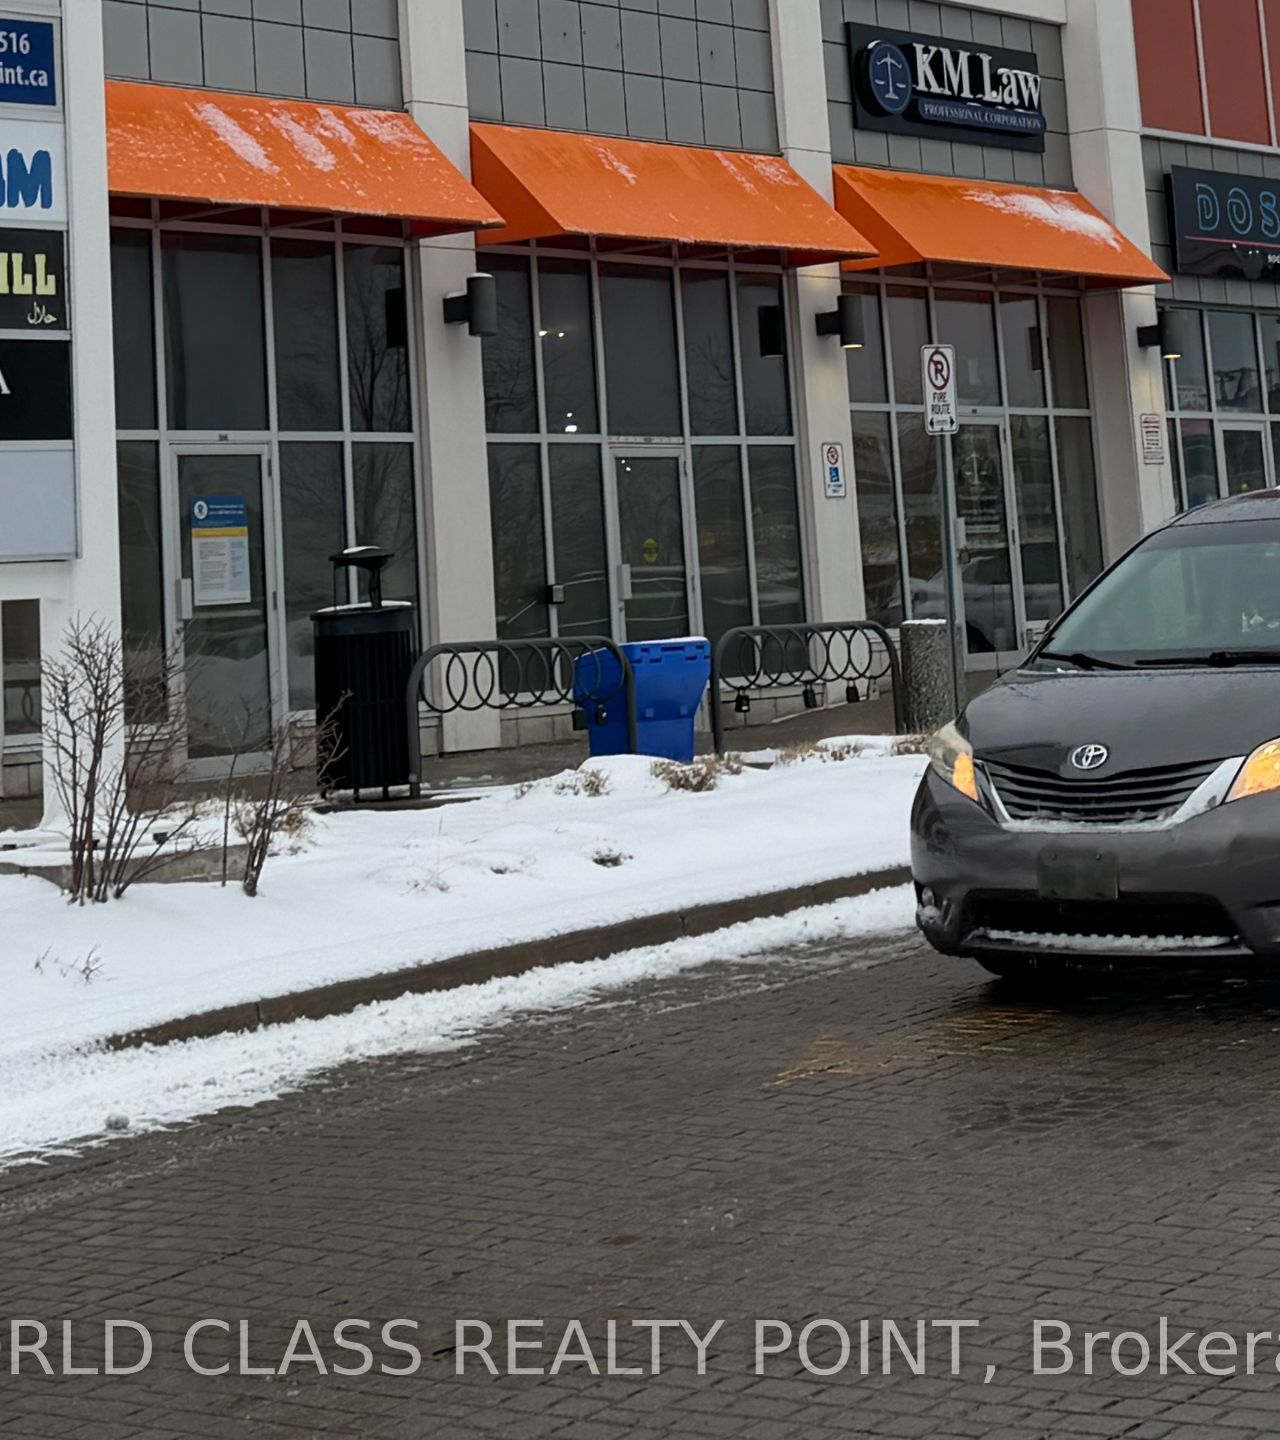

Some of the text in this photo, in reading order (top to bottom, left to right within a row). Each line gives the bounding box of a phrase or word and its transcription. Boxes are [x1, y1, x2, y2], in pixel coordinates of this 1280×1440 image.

[912, 42, 1042, 109] KM Law
[923, 103, 1042, 130] PROFESSIONAL CORPORATION
[932, 391, 948, 403] FIRE
[930, 403, 952, 416] ROUTE
